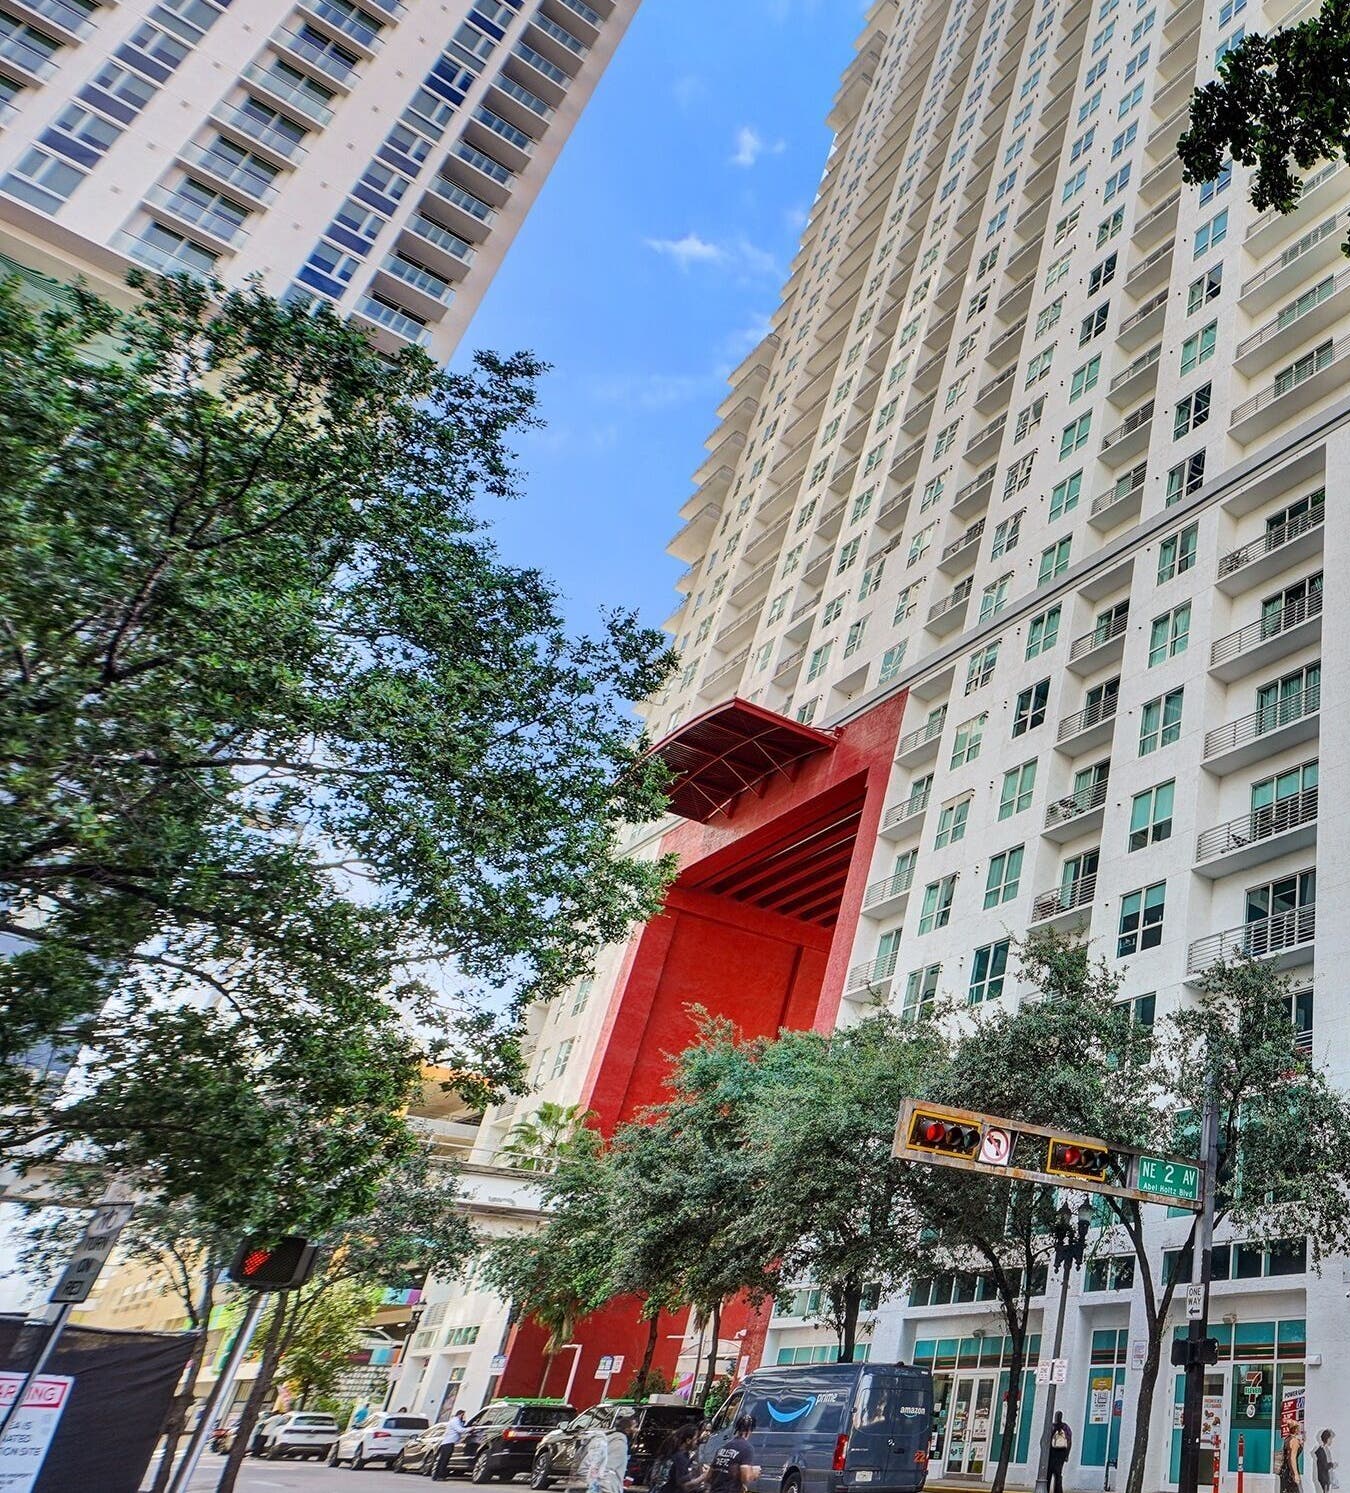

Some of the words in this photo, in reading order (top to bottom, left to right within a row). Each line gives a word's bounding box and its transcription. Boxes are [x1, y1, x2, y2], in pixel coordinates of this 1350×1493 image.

[1142, 1161, 1157, 1179] NE
[1164, 1164, 1175, 1184] 2
[1182, 1169, 1196, 1186] AV
[1143, 1182, 1158, 1191] Abel
[1160, 1184, 1177, 1195] Holtz
[1178, 1188, 1193, 1198] Blvd
[1188, 1287, 1202, 1297] ONE
[1187, 1297, 1202, 1307] WAY
[815, 1391, 838, 1406] prime
[900, 1406, 926, 1416] amazon
